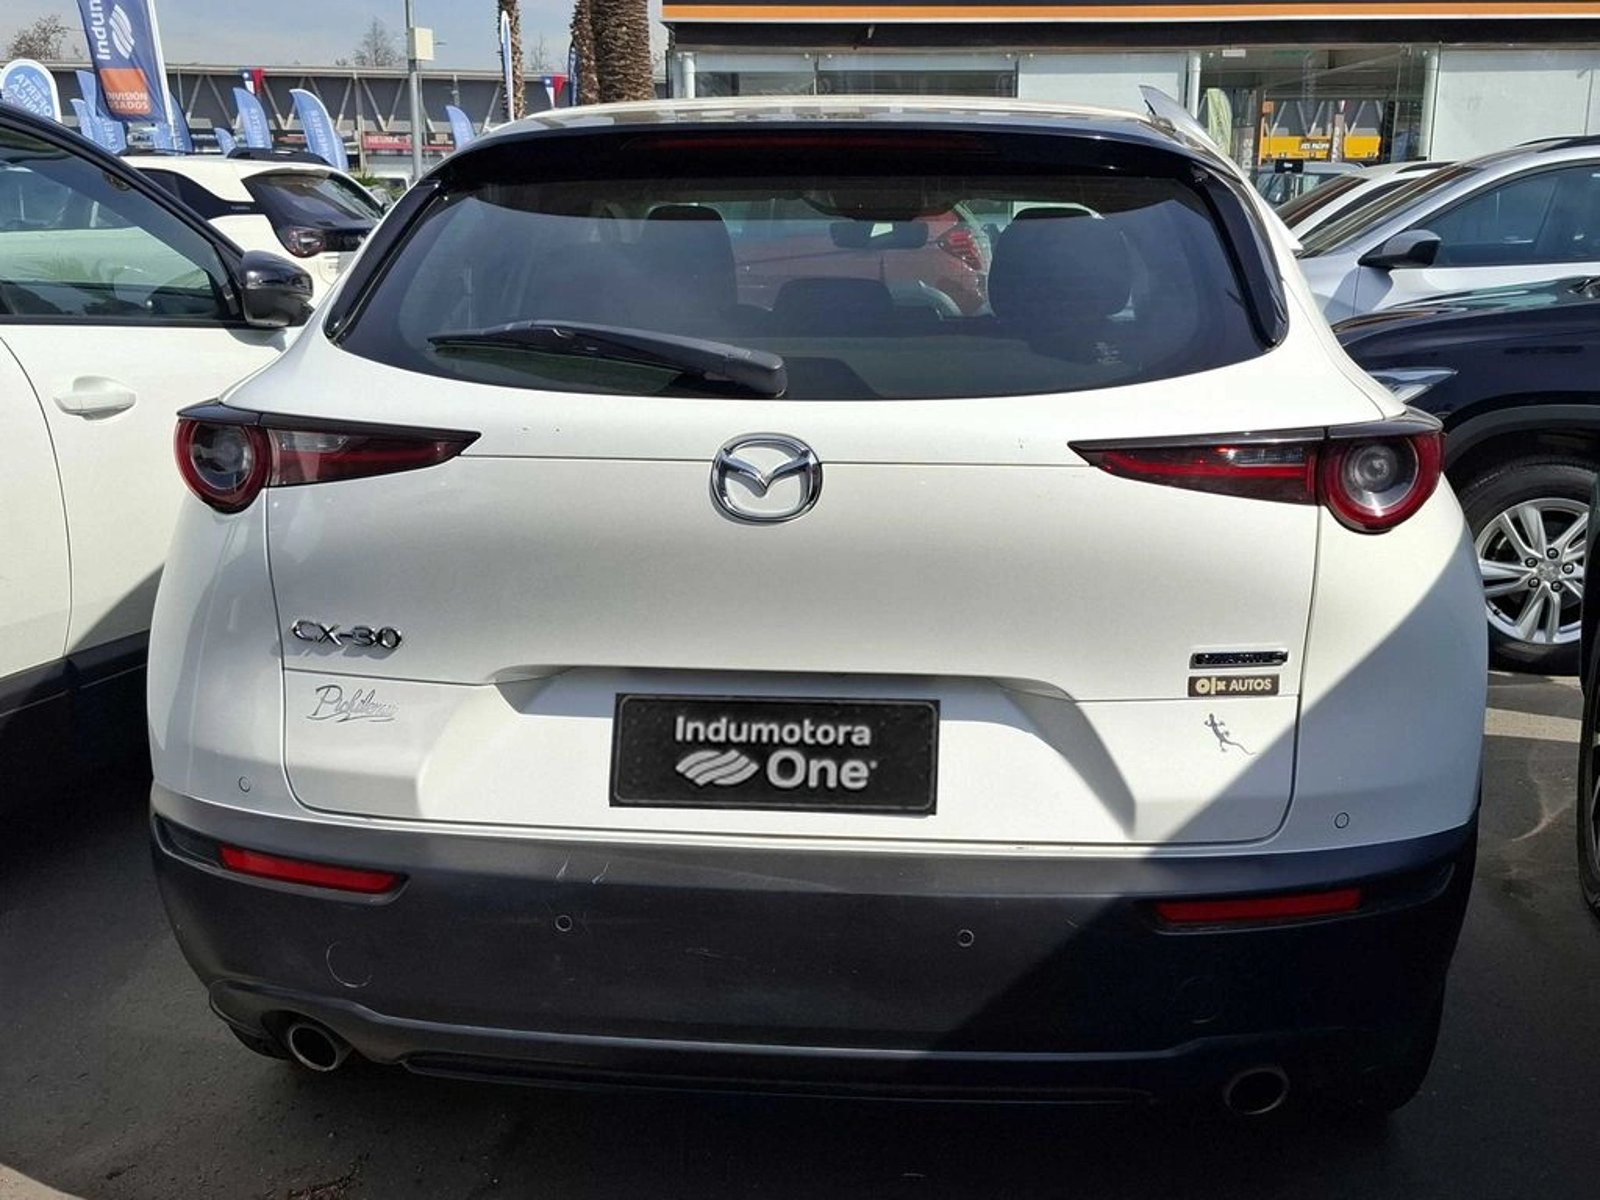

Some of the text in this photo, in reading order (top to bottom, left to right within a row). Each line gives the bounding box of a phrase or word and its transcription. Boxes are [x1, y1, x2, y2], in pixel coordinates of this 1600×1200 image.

[109, 101, 149, 110] SADOS
[291, 620, 402, 649] CX-30
[1229, 678, 1272, 692] AUTOS
[675, 715, 871, 746] Indumotora
[766, 749, 869, 789] One
